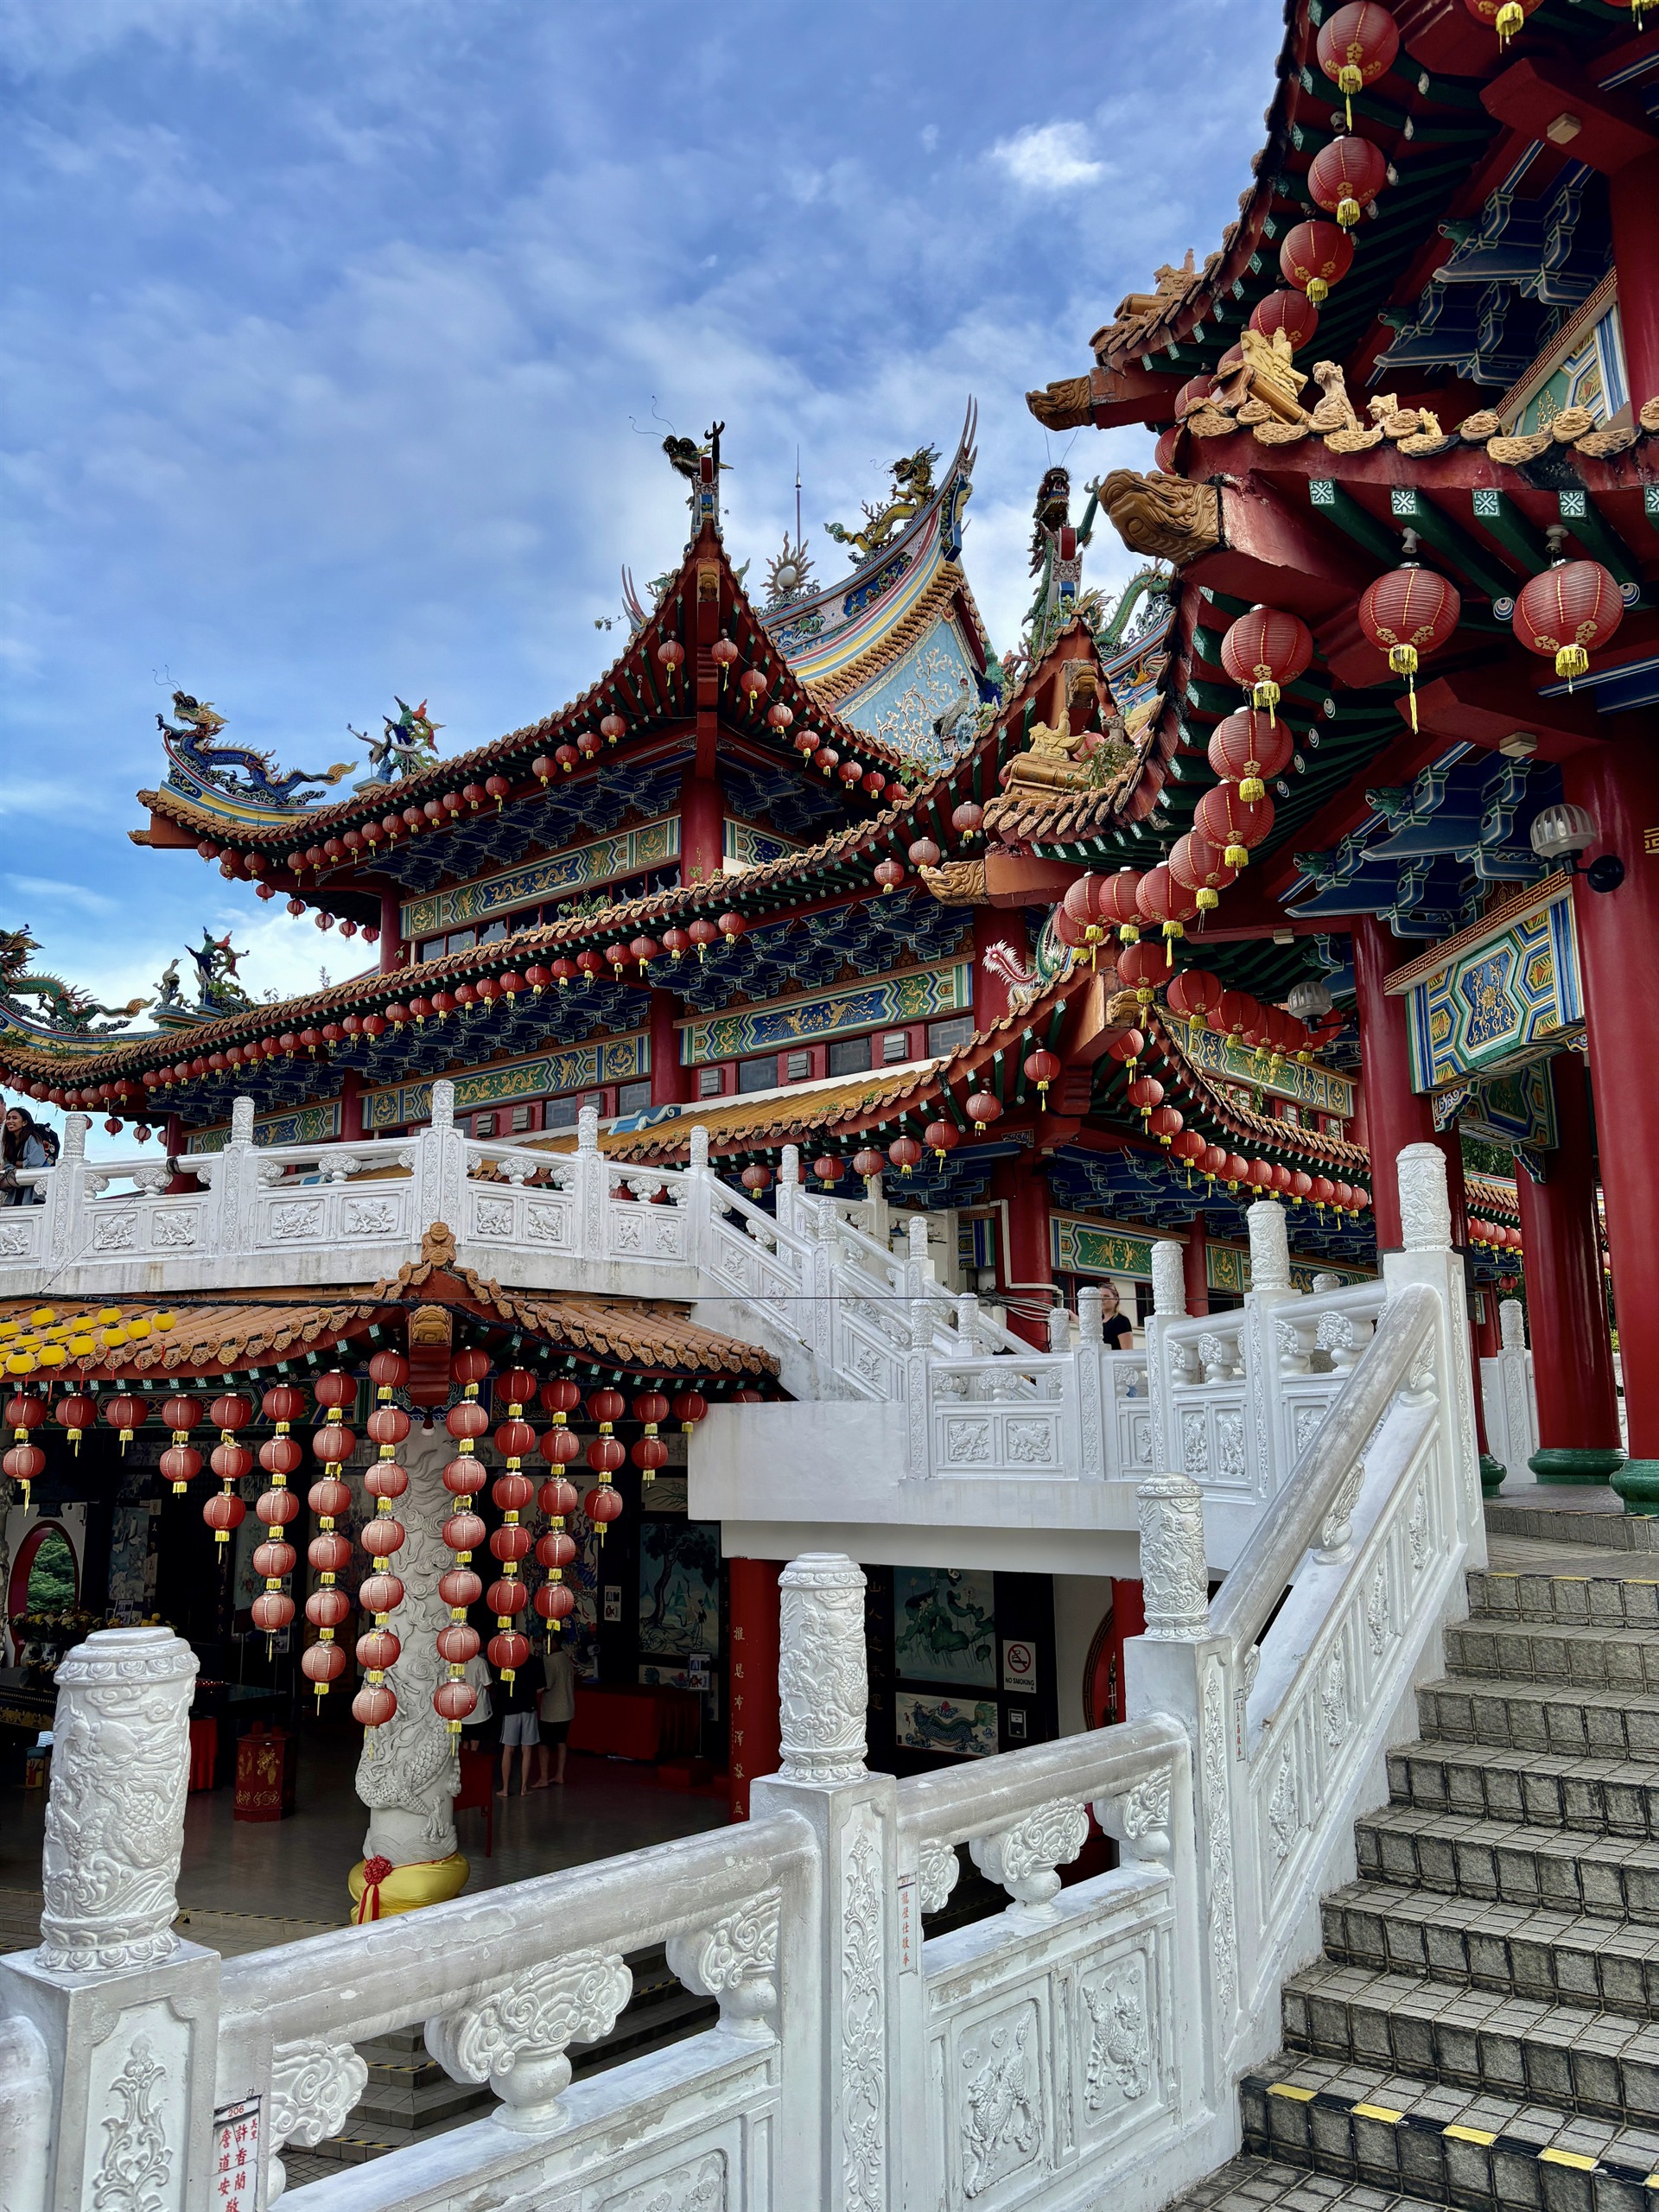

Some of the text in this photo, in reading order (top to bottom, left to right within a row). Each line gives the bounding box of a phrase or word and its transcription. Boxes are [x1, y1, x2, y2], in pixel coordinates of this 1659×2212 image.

[227, 2105, 245, 2118] 206
[250, 2118, 258, 2140] 美里
[234, 2123, 249, 2191] 許香蘭
